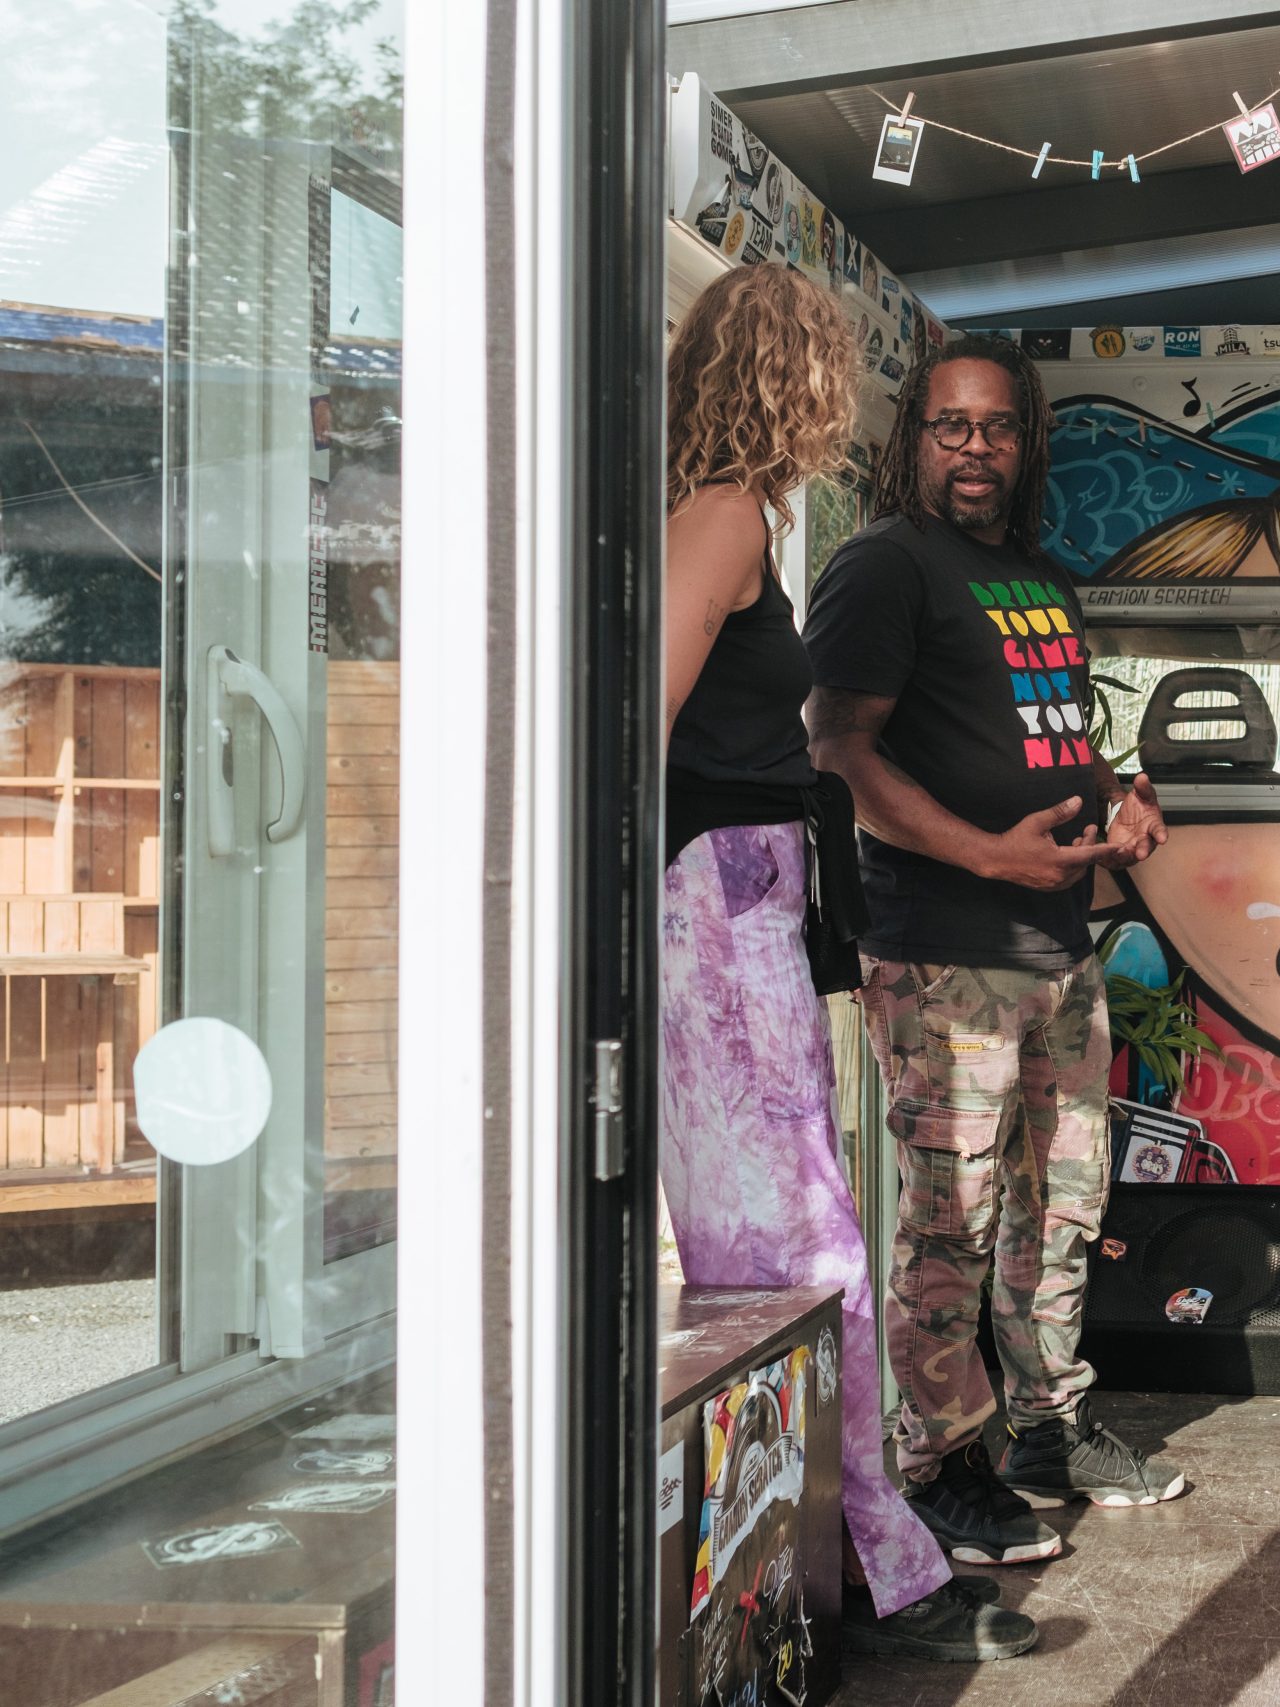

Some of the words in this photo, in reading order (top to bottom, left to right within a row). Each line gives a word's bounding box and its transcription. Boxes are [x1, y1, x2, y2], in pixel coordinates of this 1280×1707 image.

[710, 101, 733, 131] SIMER
[749, 215, 773, 256] TEAM
[1164, 330, 1200, 344] RON
[1217, 342, 1247, 354] MILA
[967, 580, 1067, 607] BRING
[985, 608, 1074, 637] YOUR
[1003, 637, 1085, 669] GAME
[1010, 671, 1071, 703] NOT
[1023, 737, 1093, 769] NAM
[718, 1491, 750, 1554] CAMION
[748, 1444, 783, 1510] SCRATCH
